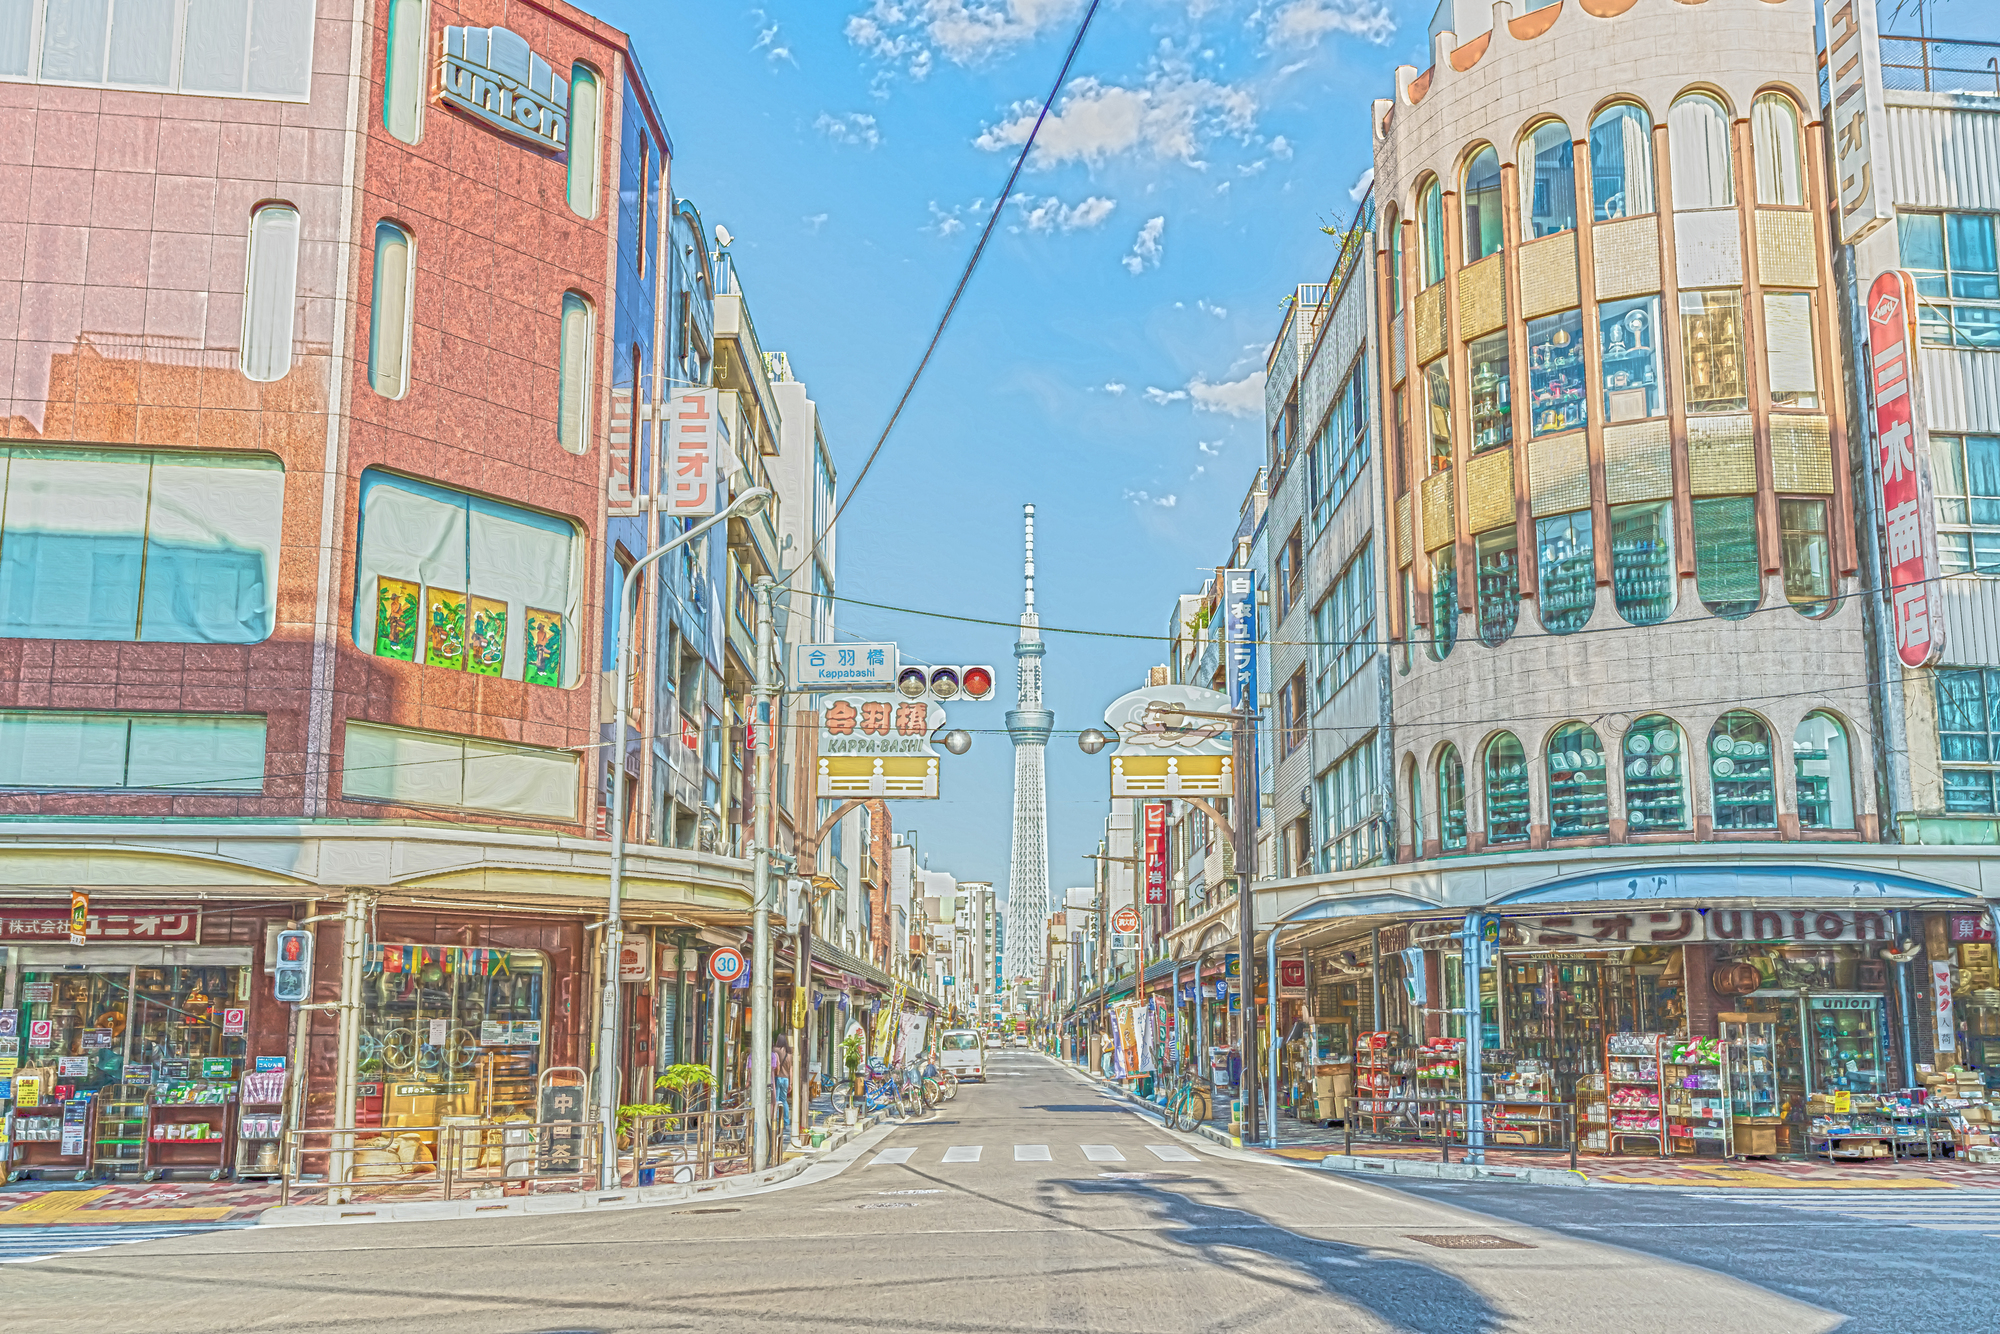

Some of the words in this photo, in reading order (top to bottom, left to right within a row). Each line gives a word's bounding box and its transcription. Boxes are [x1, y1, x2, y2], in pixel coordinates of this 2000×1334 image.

[441, 61, 567, 144] union
[1831, 0, 1870, 219] ユニオン
[675, 396, 710, 507] ユニオン
[1873, 339, 1929, 650] 三木商店
[808, 649, 885, 666] 合羽橋
[818, 668, 875, 679] Kappabashi
[825, 700, 928, 736] 合羽橋
[1147, 807, 1164, 902] ビニール岩井
[1713, 910, 1886, 940] union
[717, 957, 737, 972] 30
[1822, 998, 1871, 1009] union
